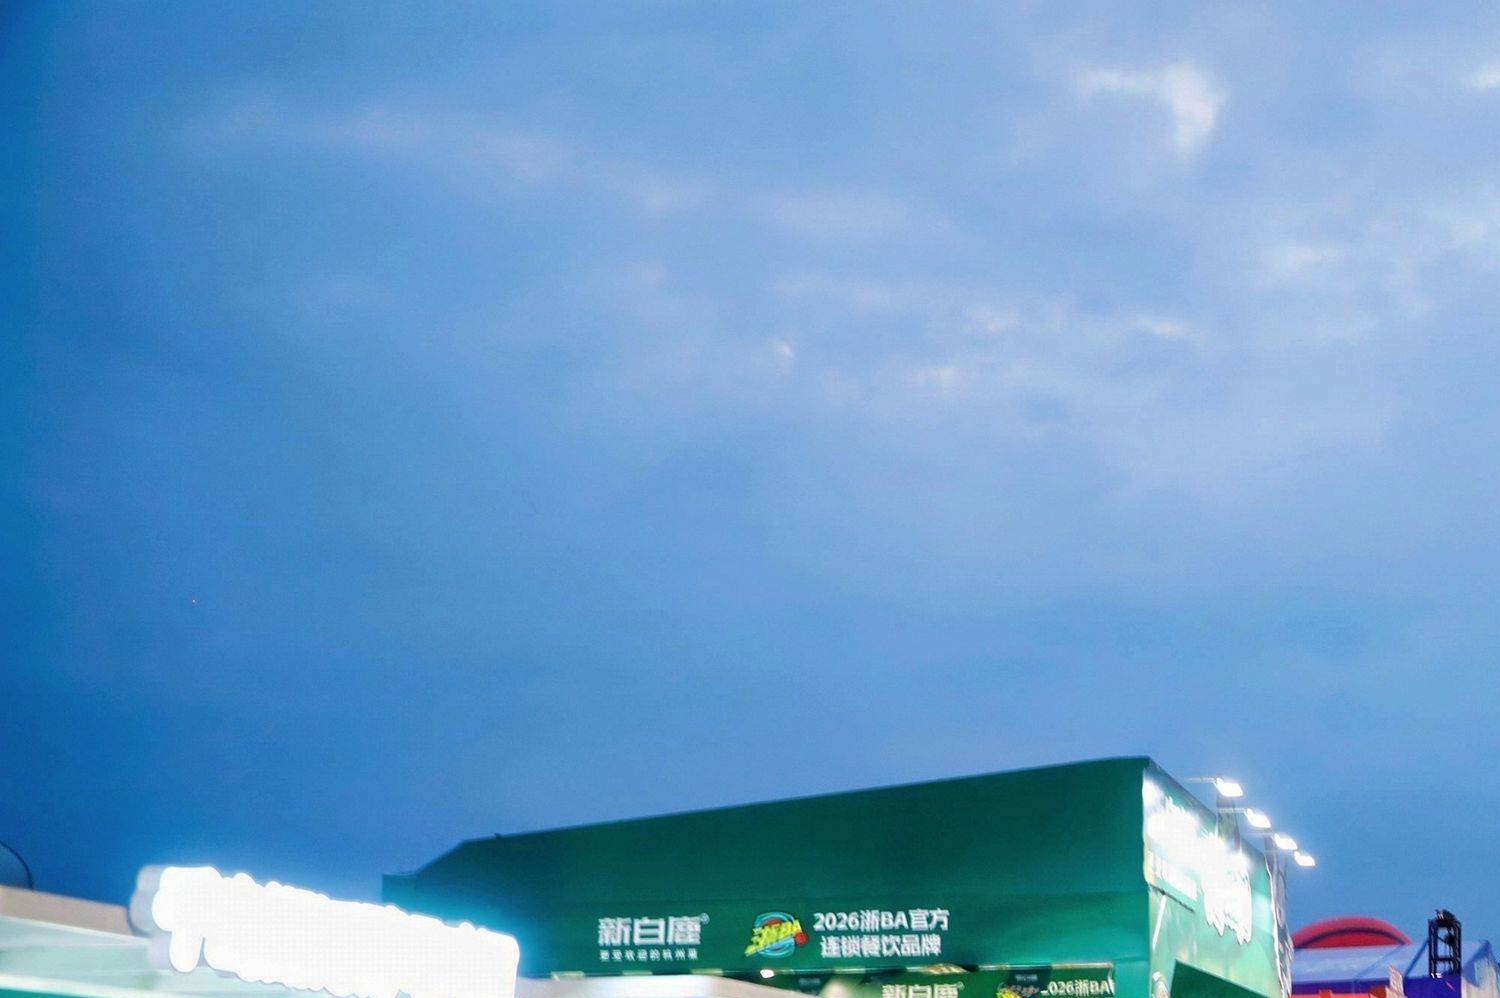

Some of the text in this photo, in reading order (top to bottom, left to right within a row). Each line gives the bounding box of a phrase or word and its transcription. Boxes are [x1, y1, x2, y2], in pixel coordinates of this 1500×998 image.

[812, 909, 950, 932] 2026浙BA官方
[820, 934, 942, 958] 连锁餐饮品牌
[1041, 979, 1110, 996] 026浙BA
